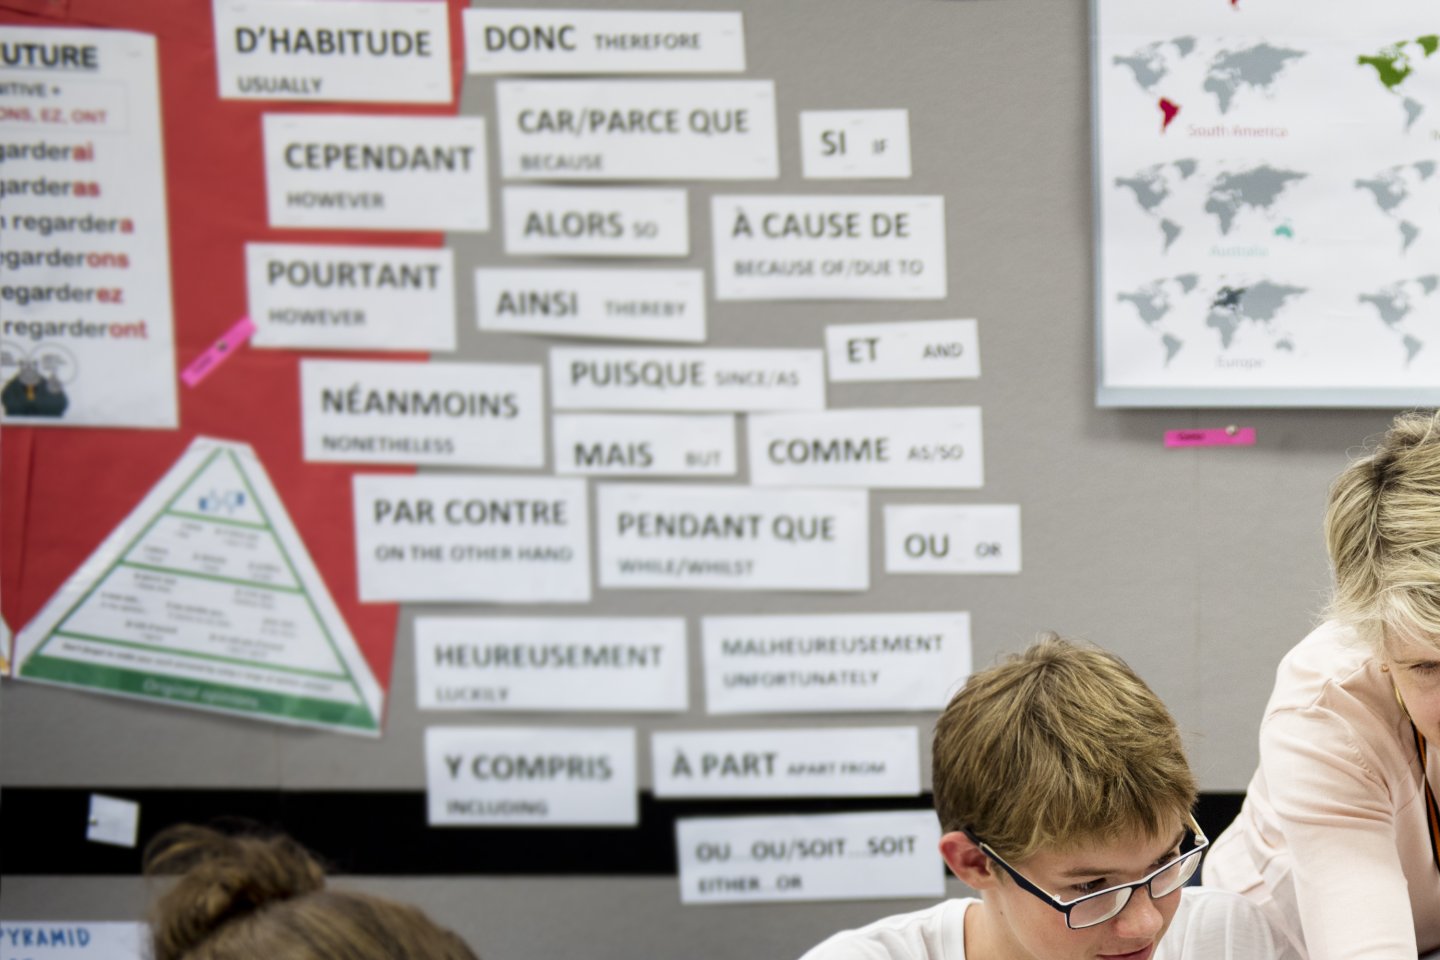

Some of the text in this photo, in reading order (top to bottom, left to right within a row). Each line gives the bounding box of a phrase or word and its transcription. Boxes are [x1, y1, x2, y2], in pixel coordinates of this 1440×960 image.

[235, 27, 431, 57] D'HABITUDE
[484, 26, 701, 52] DONC THEREFORE
[0, 42, 98, 69] UTURE
[238, 76, 322, 94] USUALLY
[517, 108, 749, 136] CAR/PARCE QUE
[820, 132, 888, 155] SI IF
[284, 143, 473, 171] CEPENDANT
[521, 154, 603, 172] BECAUSE
[287, 192, 384, 210] HOWEVER
[13, 214, 134, 236] regardera
[523, 212, 659, 239] ALORS SO
[733, 206, 910, 239] À CAUSE DE
[267, 260, 440, 290] POURTANT
[734, 259, 924, 277] BECAUSE OF/DUE TO
[496, 291, 687, 318] AINSI THEREBY
[269, 309, 365, 325] HOWEVER
[3, 320, 148, 340] regarderont
[846, 338, 963, 362] ET AND
[570, 361, 799, 390] PUISQUE SINCE/AS
[321, 382, 519, 419] NÉANMOINS
[321, 435, 455, 455] NONETHELESS
[574, 443, 721, 467] MAIS BUT
[768, 438, 964, 464] COMME AS/SO
[375, 499, 568, 525] PAR CONTRE
[617, 512, 836, 542] PENDANT QUE
[375, 545, 573, 563] ON THE OTHER HAND
[904, 534, 1001, 557] OU OR
[618, 557, 754, 576] WHILE/WHILST
[434, 645, 663, 668] HEUREUSEMENT
[722, 634, 943, 657] MALHEUREUSEMENT
[723, 670, 879, 689] UNFORTUNATELY
[436, 686, 507, 702] LUCKILY
[444, 756, 613, 781] Y COMPRIS
[672, 747, 885, 778] À PART APART FROM
[446, 800, 547, 816] INCLUDING
[0, 927, 90, 948] YRAMID
